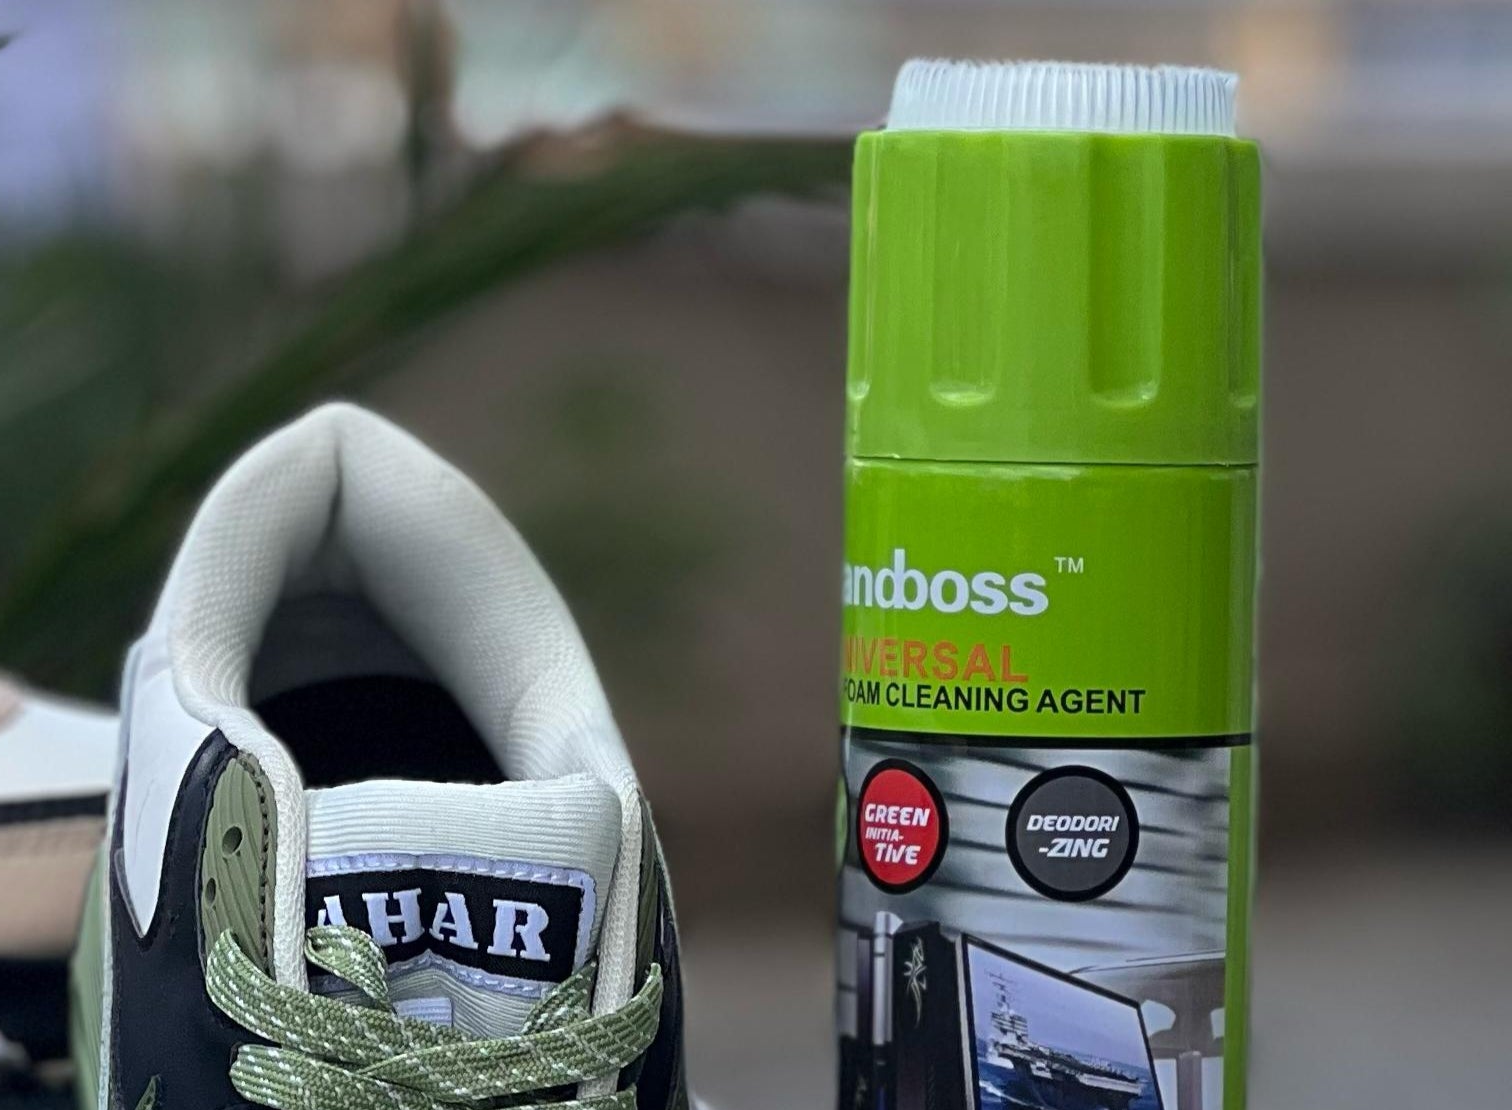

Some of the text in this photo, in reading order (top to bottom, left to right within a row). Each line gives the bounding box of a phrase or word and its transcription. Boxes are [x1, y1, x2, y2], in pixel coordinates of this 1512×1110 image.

[885, 683, 1029, 714] CLEANING
[1036, 688, 1146, 714] AGENT
[864, 803, 930, 827] GREEN
[1026, 814, 1120, 832] DEODORI
[864, 826, 905, 842] INITIA-
[874, 842, 922, 866] TIVE
[1038, 838, 1110, 858] -ZING
